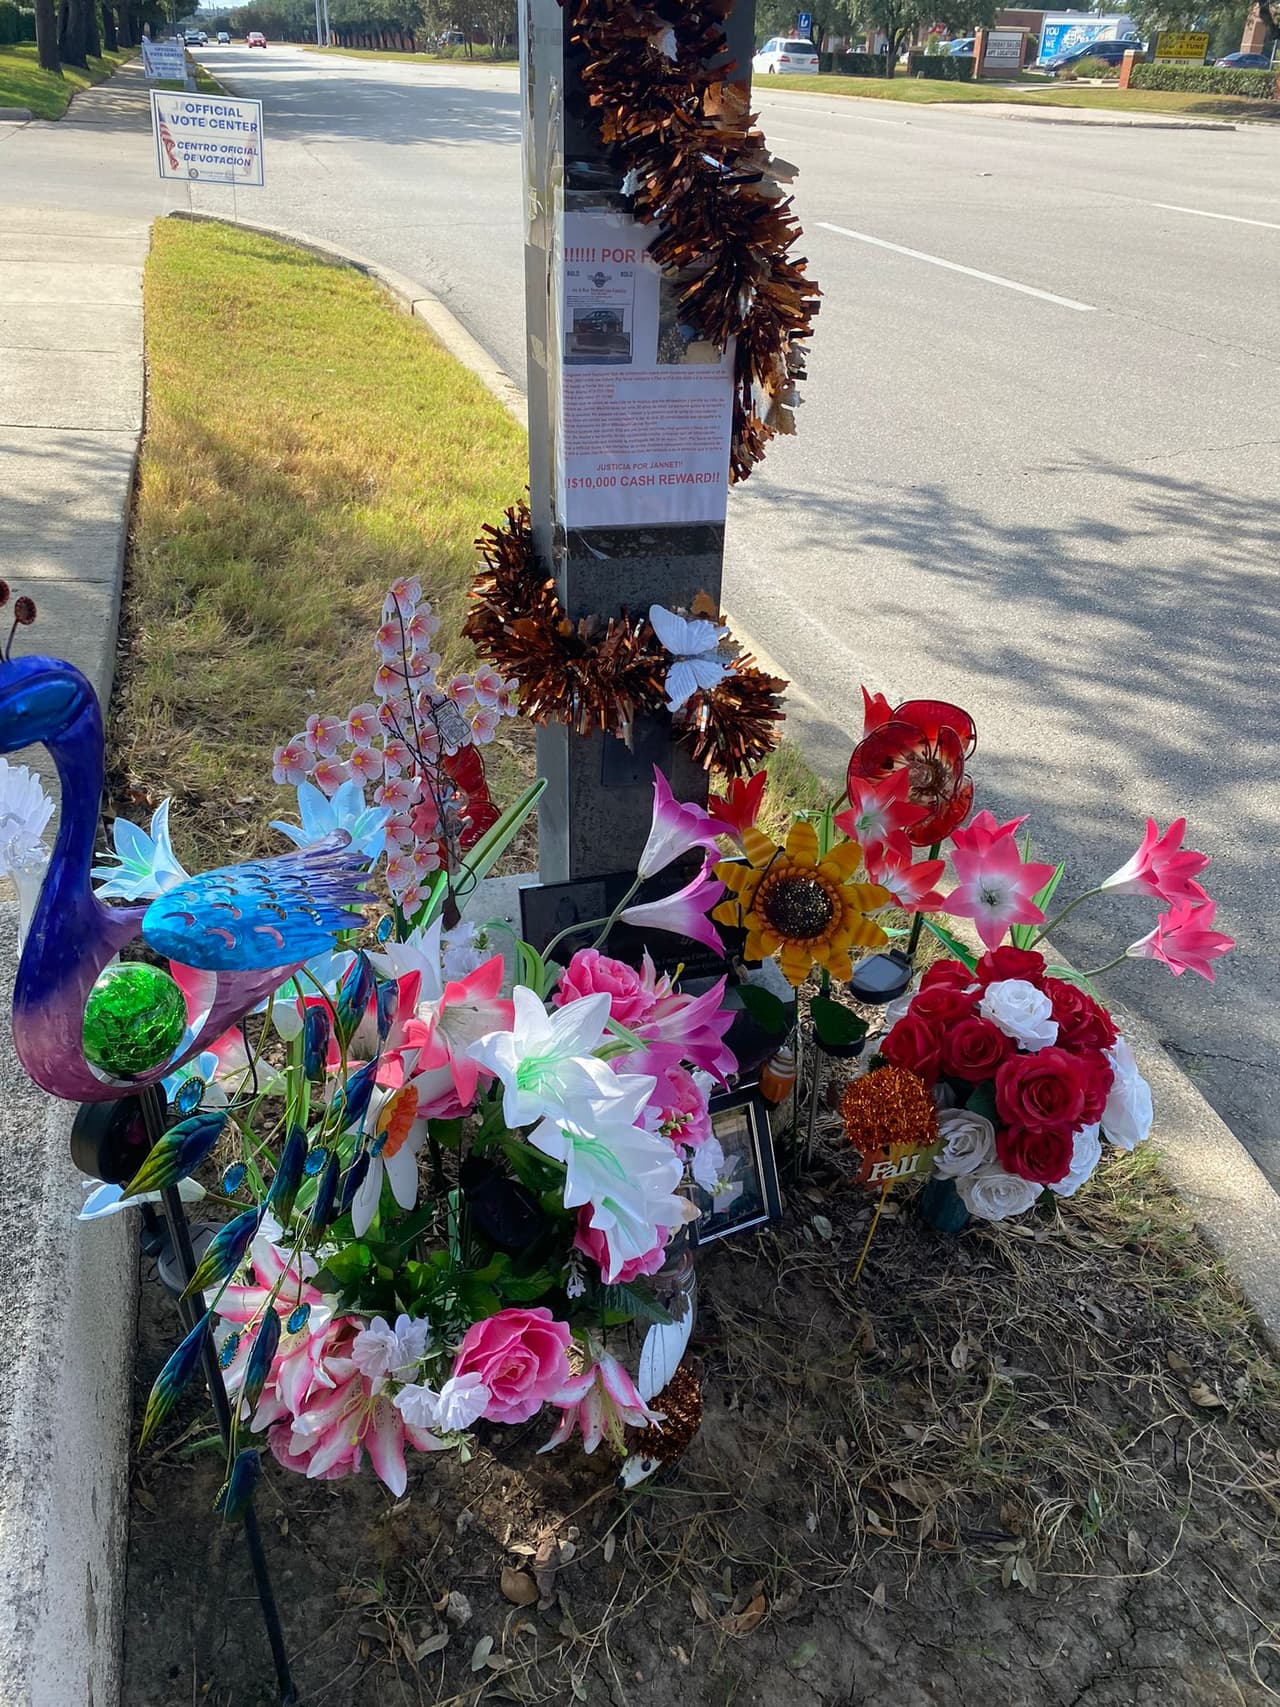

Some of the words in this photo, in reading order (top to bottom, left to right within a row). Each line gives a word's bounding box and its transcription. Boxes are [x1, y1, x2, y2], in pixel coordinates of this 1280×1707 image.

[1046, 26, 1060, 36] YOU
[1045, 39, 1056, 48] WE
[185, 103, 243, 118] OFFICIAL
[170, 115, 205, 128] VOTE
[209, 118, 258, 132] CENTER
[177, 141, 218, 152] CENTRO
[220, 144, 259, 156] OFICIAL
[183, 153, 197, 162] DE
[601, 248, 636, 264] POR
[620, 475, 655, 487] CASH
[658, 472, 720, 485] REWARD!!
[867, 1154, 921, 1182] Fall
